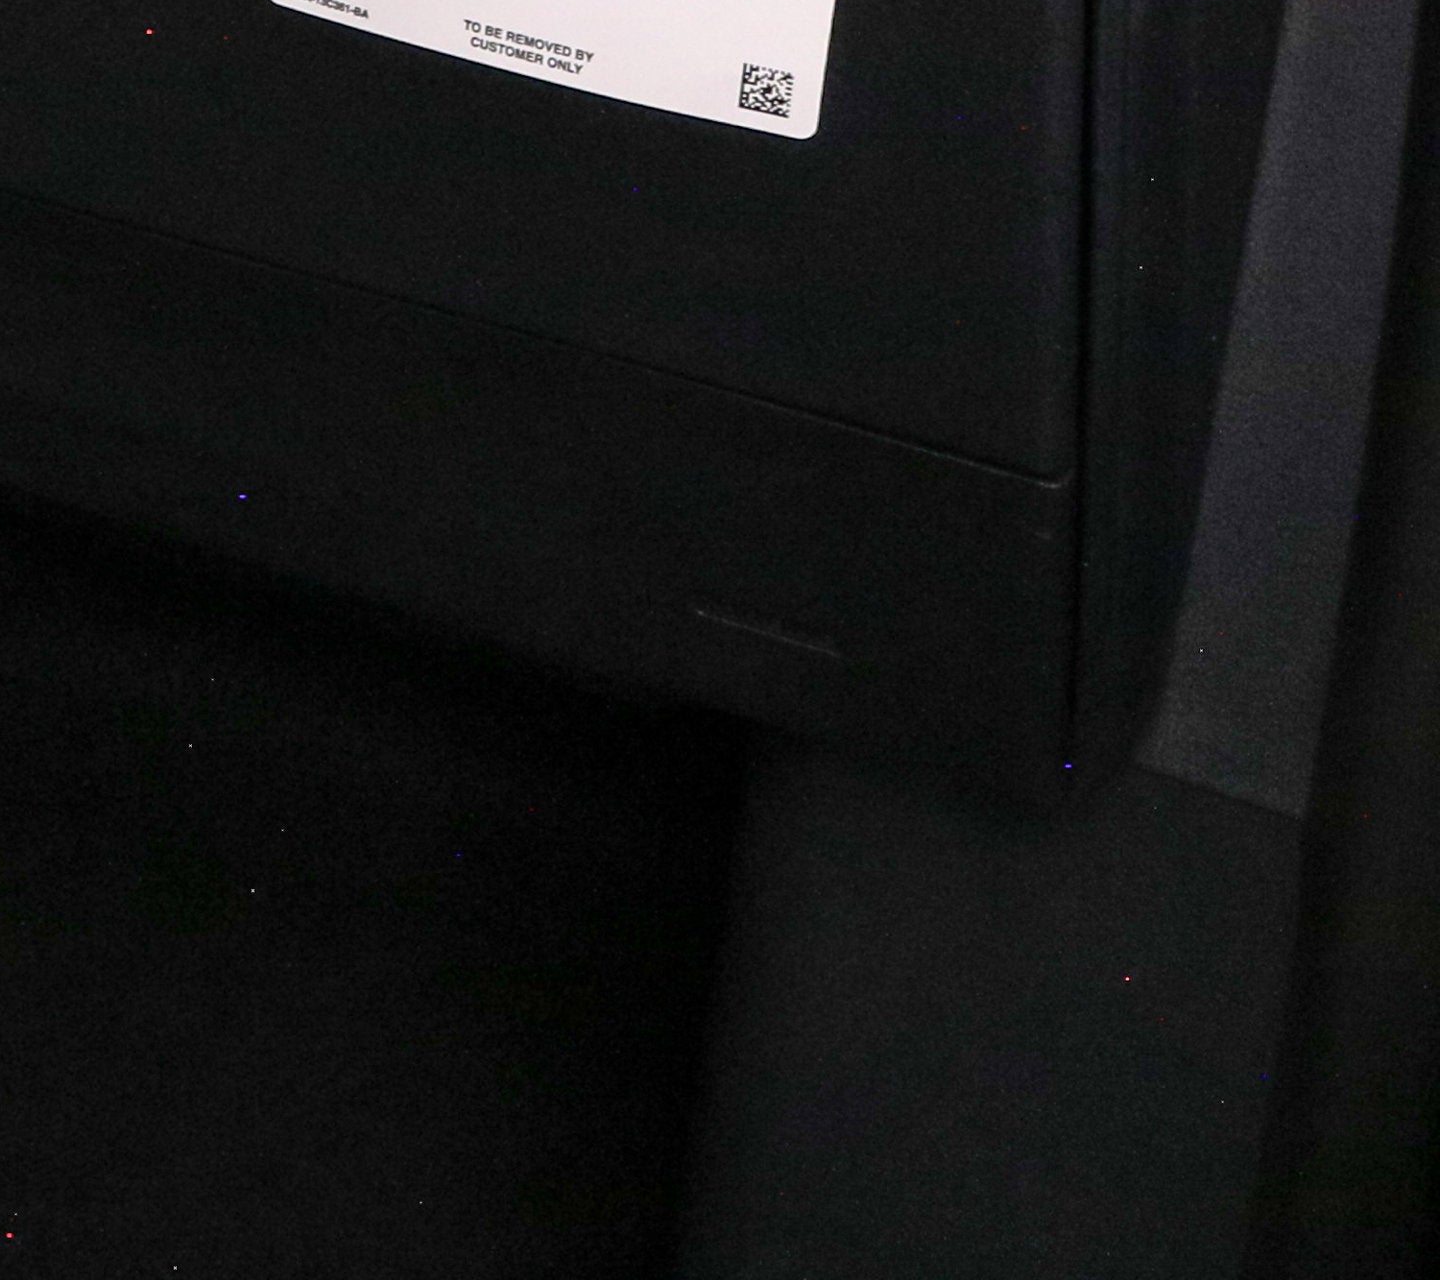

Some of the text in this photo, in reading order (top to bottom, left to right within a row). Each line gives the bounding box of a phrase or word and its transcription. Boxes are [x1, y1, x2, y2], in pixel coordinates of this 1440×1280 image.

[463, 18, 595, 63] TO BE REMOVED BY
[469, 36, 584, 75] CUSTOMER ONLY
